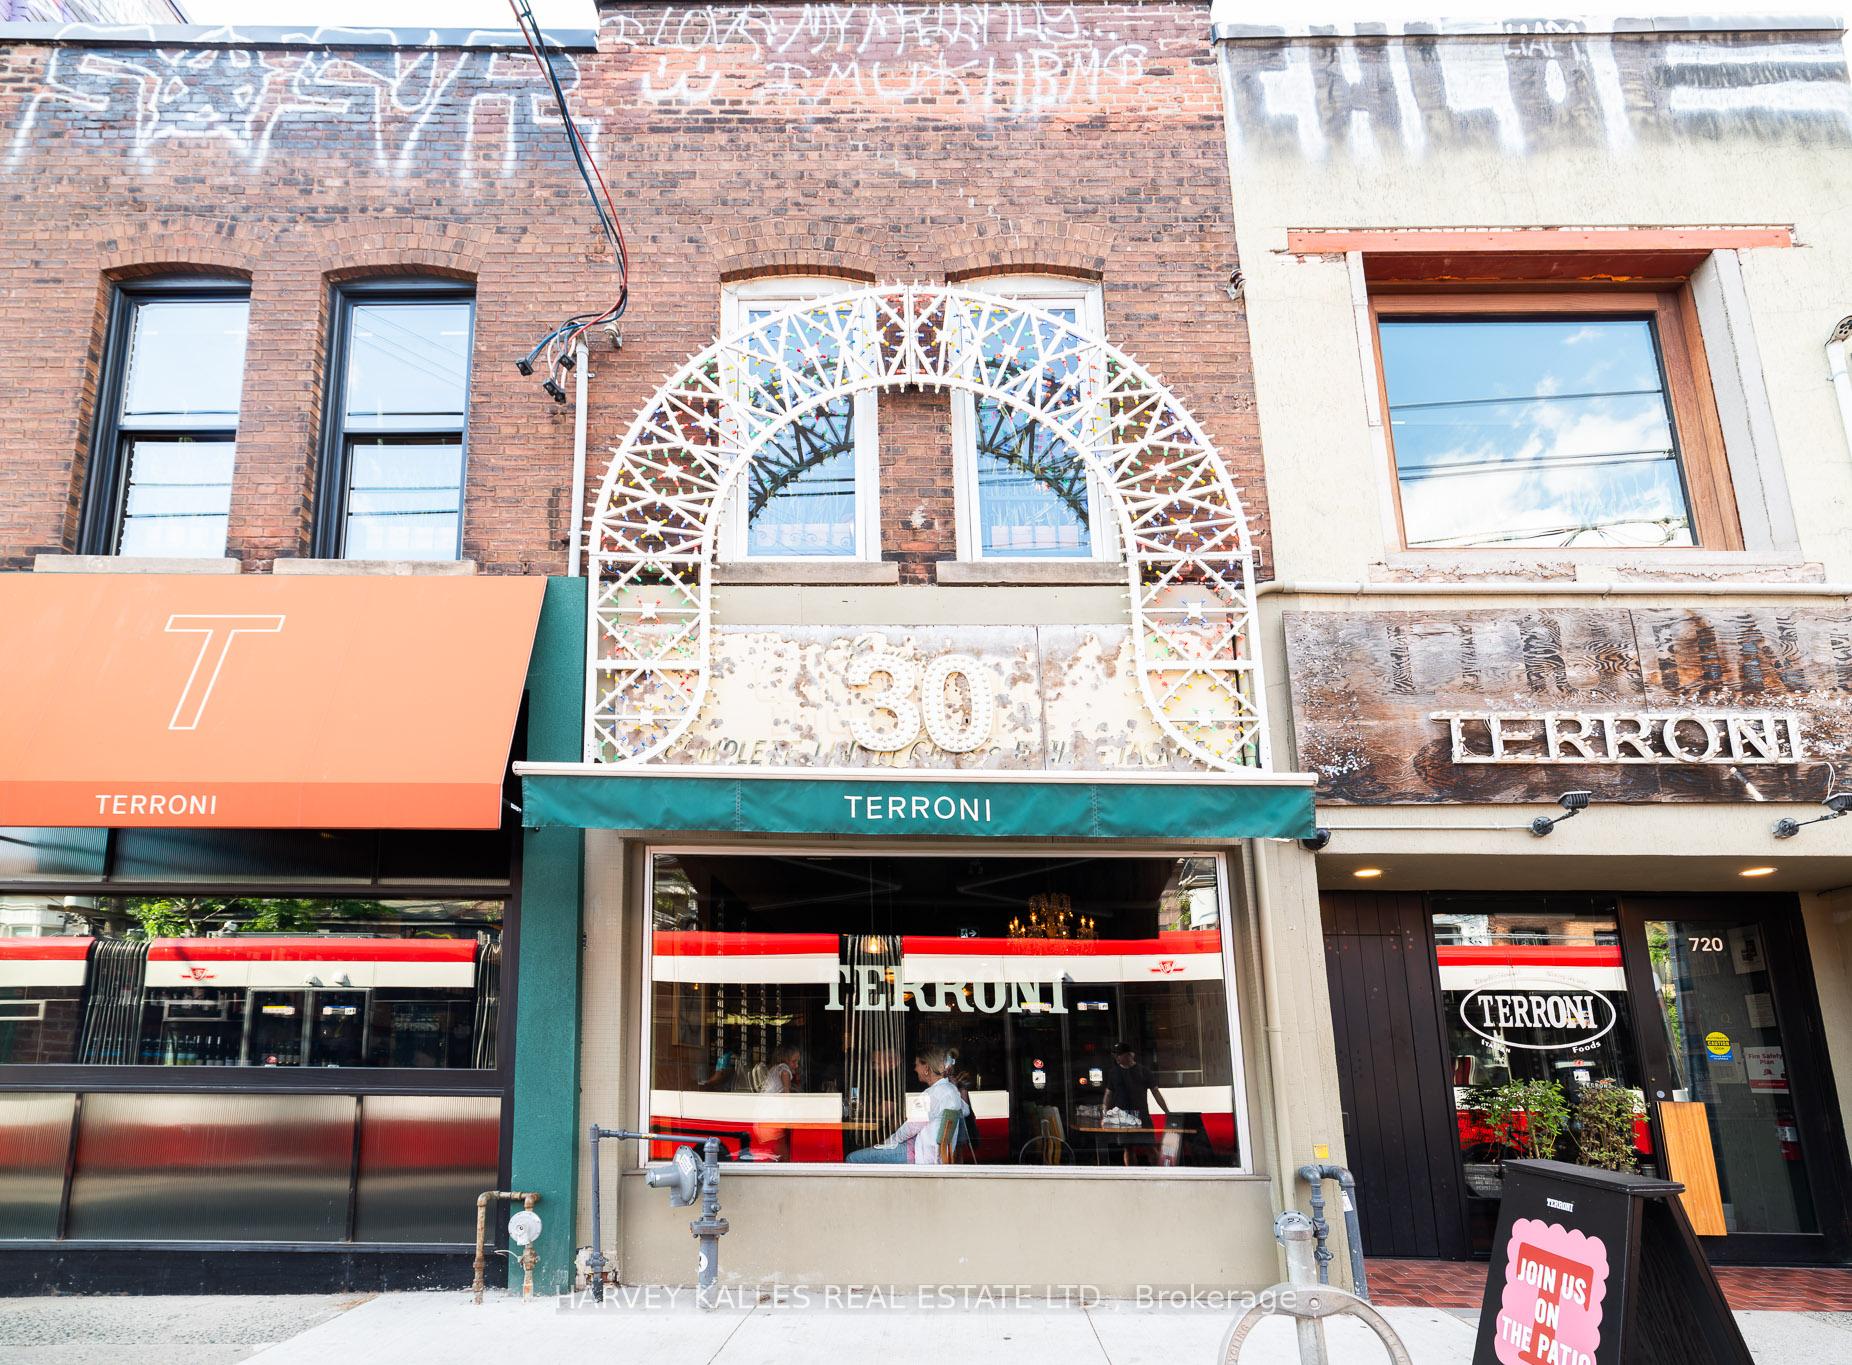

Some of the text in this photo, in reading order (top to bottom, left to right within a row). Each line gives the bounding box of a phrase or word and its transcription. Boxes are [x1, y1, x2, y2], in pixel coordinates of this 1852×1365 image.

[164, 614, 286, 730] T
[849, 653, 994, 752] 30
[1430, 713, 1804, 763] TERRONI
[95, 795, 217, 815] TERRONI
[844, 796, 991, 822] TERRONI
[1688, 937, 1724, 952] 720
[824, 963, 1069, 1014] TERRONI
[1477, 995, 1598, 1029] TERRONI
[1572, 1041, 1601, 1054] Foods
[1547, 1198, 1573, 1213] TERRONI
[1517, 1258, 1587, 1305] JOIN US
[1534, 1297, 1560, 1330] ON
[1501, 1315, 1533, 1353] THE
